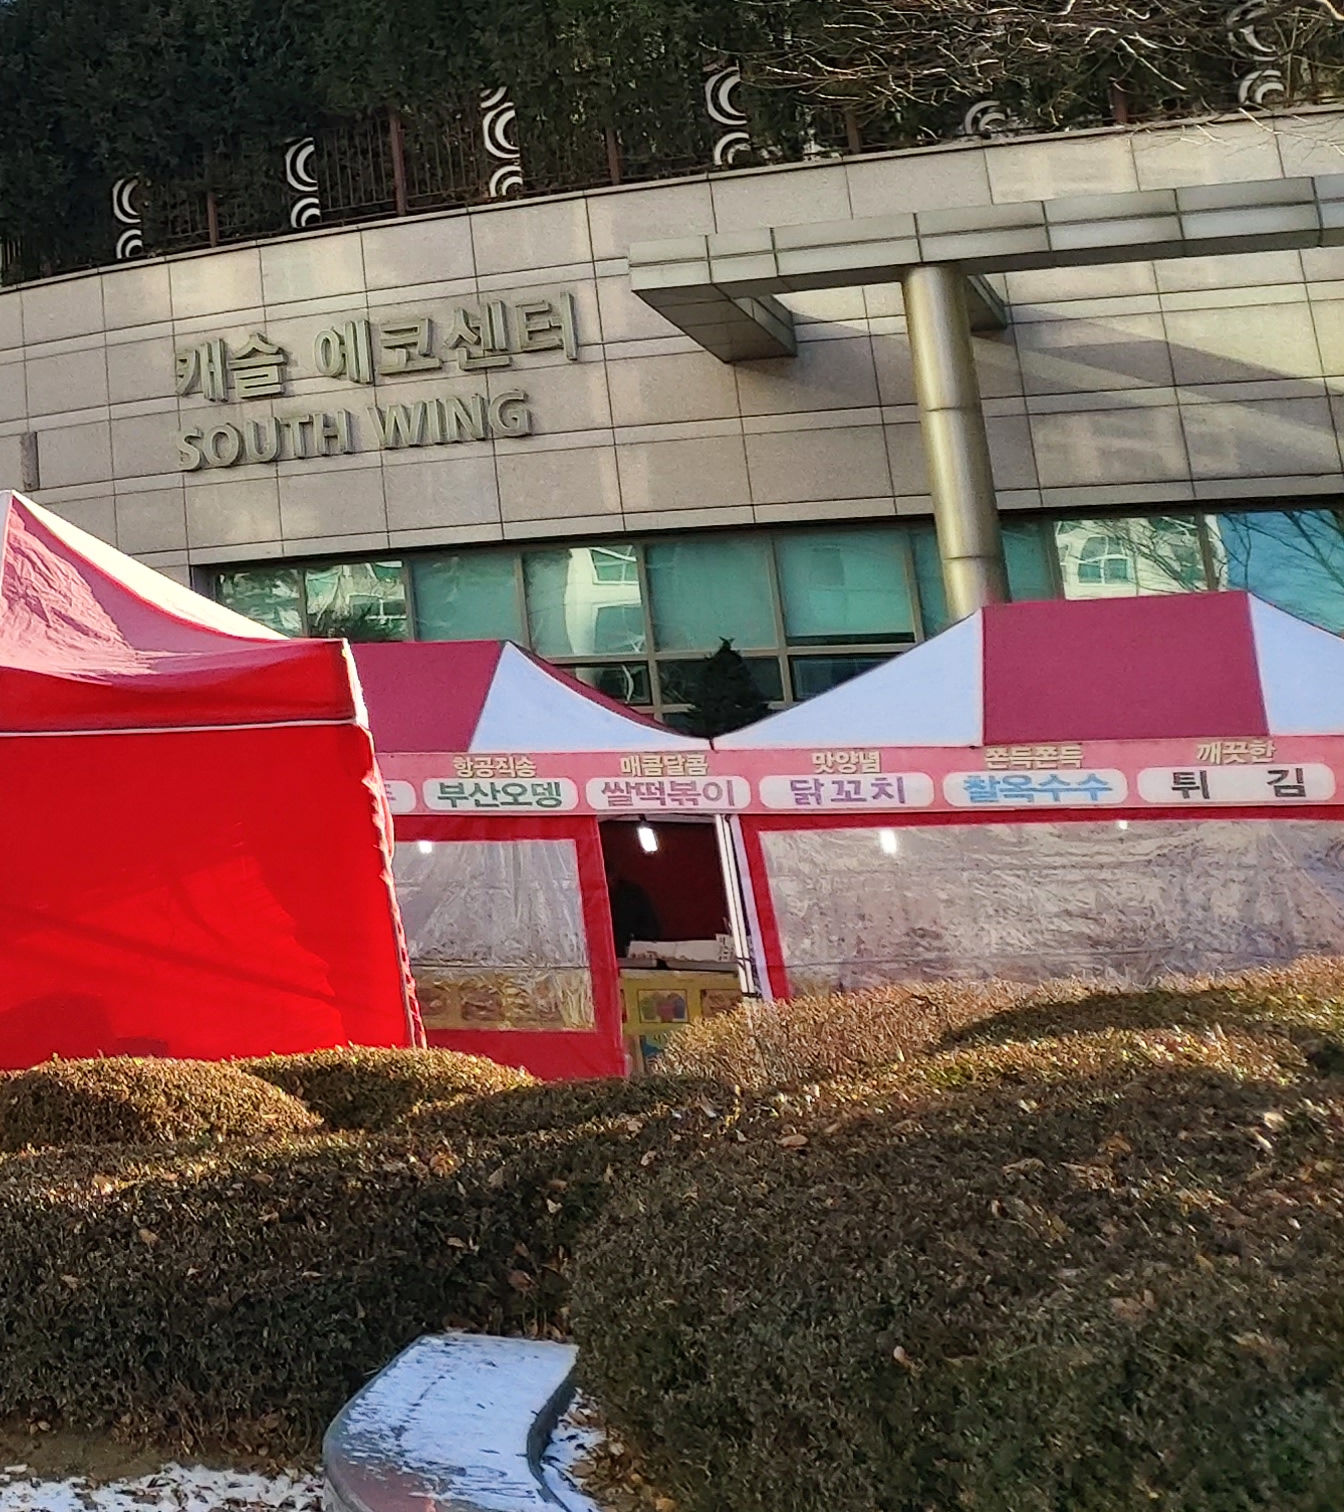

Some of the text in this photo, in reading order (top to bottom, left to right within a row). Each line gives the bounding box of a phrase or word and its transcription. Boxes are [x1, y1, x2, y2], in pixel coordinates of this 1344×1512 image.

[175, 290, 580, 401] 캐슬 에코센터
[176, 388, 532, 472] SOUTH WING
[812, 749, 882, 774] 맛양념
[984, 744, 1083, 770] 쫀득쫀득
[1196, 739, 1277, 764] 깨끗한
[453, 754, 537, 778] 항공직송
[620, 754, 708, 777] 매콤달콤
[437, 781, 562, 808] 부산오뎅
[601, 779, 735, 807] 쌀떡볶이
[962, 772, 1113, 803] 찰옥수수
